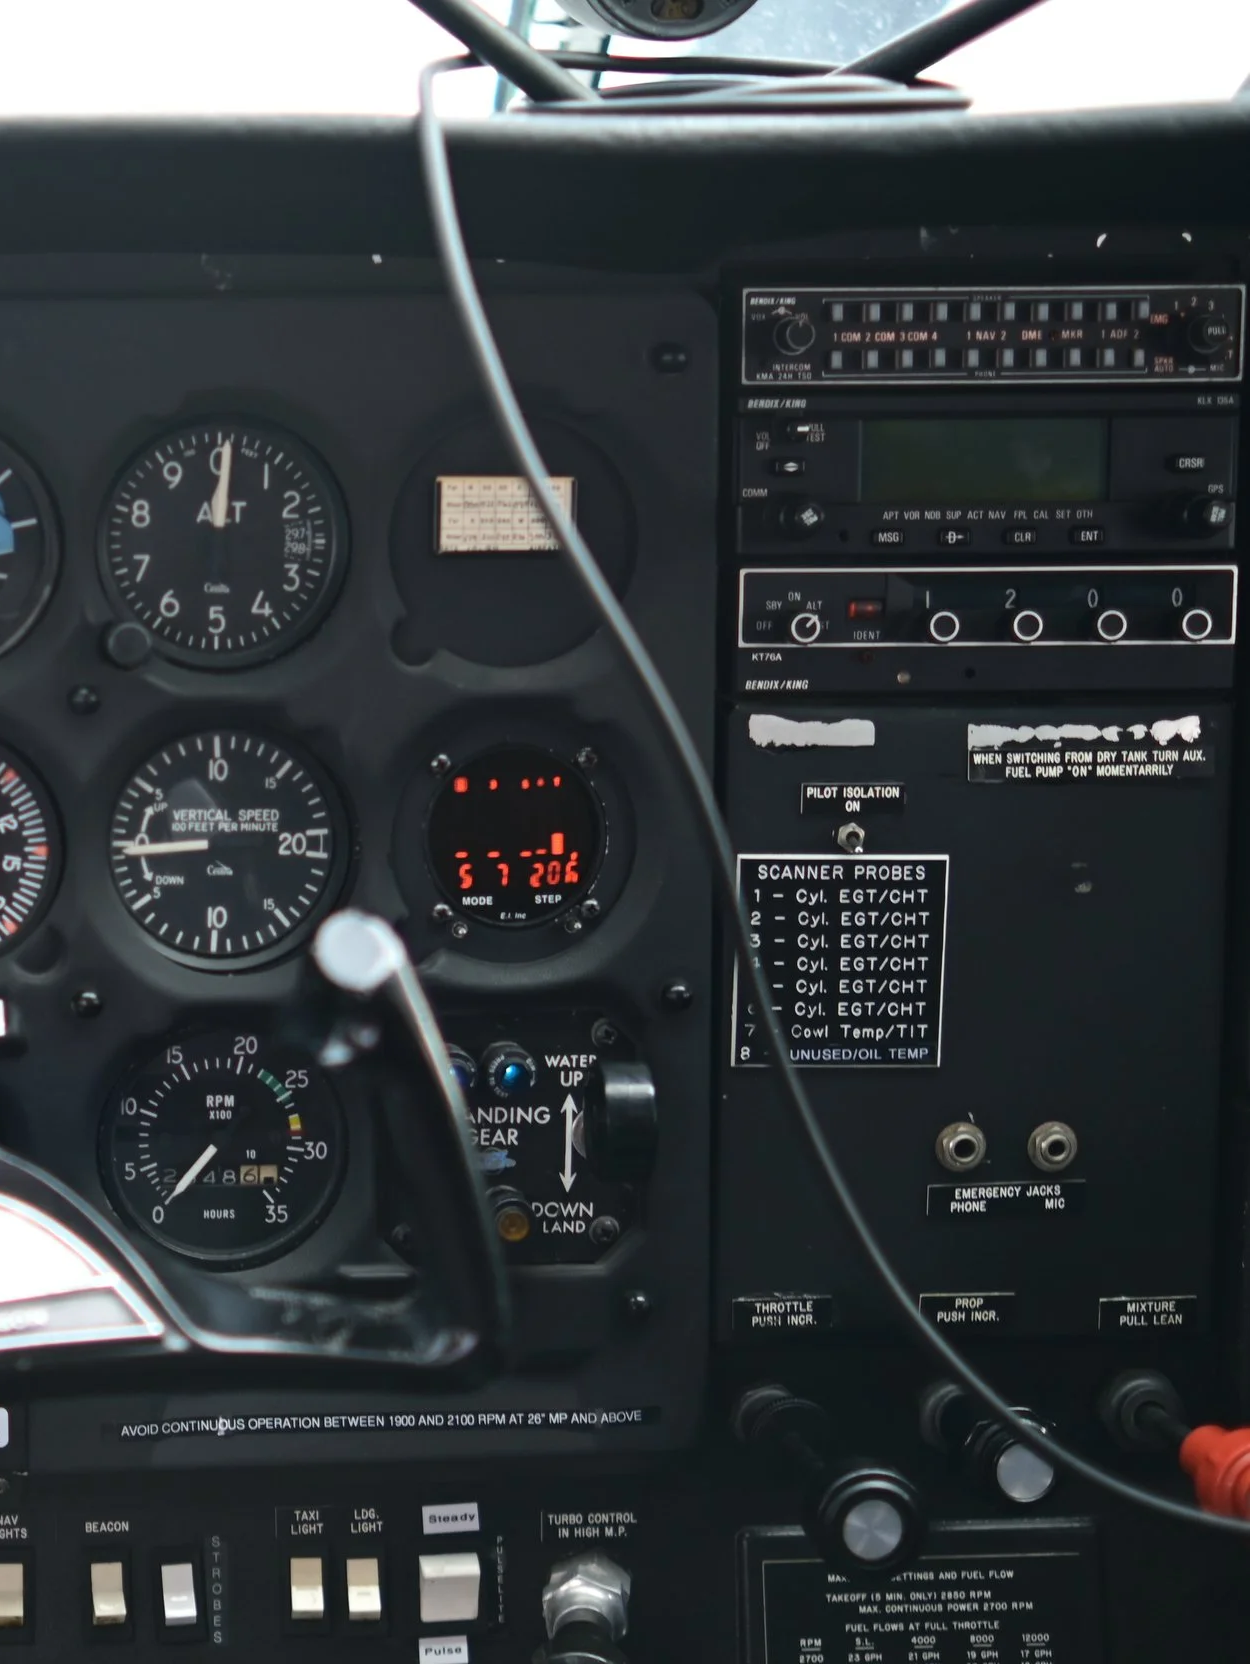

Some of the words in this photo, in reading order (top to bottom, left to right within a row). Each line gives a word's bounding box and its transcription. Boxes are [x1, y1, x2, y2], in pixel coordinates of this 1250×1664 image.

[841, 333, 861, 342] COM
[875, 333, 895, 342] COM
[1022, 331, 1042, 340] DME
[1061, 330, 1083, 339] MKR
[1179, 458, 1204, 469] CRSR
[163, 461, 183, 490] 9
[742, 488, 768, 497] COMM
[131, 499, 151, 528] 8
[882, 511, 899, 520] APT
[903, 511, 920, 520] VOR
[878, 533, 899, 542] MSG
[251, 590, 273, 617] 4
[765, 601, 782, 610] SBY
[806, 601, 822, 610] ALT
[208, 606, 226, 633] 5
[853, 631, 881, 640] IDENT
[751, 653, 782, 661] KT76A
[745, 680, 809, 690] BENDIX/KING
[973, 752, 1002, 765] WHEN
[1006, 752, 1061, 764] SWITCHING
[1065, 751, 1093, 763] FROM
[1097, 751, 1117, 763] DRY
[1121, 750, 1148, 762] TANK
[1152, 750, 1179, 762] TURN
[1183, 749, 1206, 761] AUX.
[1005, 766, 1031, 778] FUEL
[1035, 765, 1063, 778] PUMP
[1067, 765, 1093, 777] "ON"
[1096, 764, 1174, 776] MOMENTARRILY
[806, 787, 838, 799] PILOT
[843, 786, 900, 798] ISOLATION
[845, 800, 860, 812] ON
[172, 809, 232, 821] VERTICAL
[238, 809, 279, 821] SPEED
[171, 823, 187, 832] 100
[190, 823, 215, 832] FEET
[218, 823, 238, 832] PER
[240, 823, 279, 832] MINUTE
[278, 832, 307, 855] 20
[757, 864, 844, 880] SCANNER
[854, 865, 926, 880] PROBES
[155, 875, 184, 885] DOWN
[462, 896, 493, 906] MODE
[535, 894, 562, 904] STEP
[796, 889, 828, 906] Cyl.
[839, 889, 929, 904] EGT/CHT
[791, 1024, 829, 1039] Cowl
[840, 1024, 929, 1041] Temp/TIT
[234, 1036, 258, 1055] 20
[790, 1048, 882, 1061] UNUSED/OIL
[889, 1048, 929, 1060] TEMP
[285, 1070, 309, 1089] 25
[560, 1071, 583, 1087] UP
[206, 1095, 235, 1108] RPM
[209, 1110, 232, 1120] X100
[468, 1129, 519, 1146] GEAR
[303, 1142, 328, 1160] 30
[955, 1186, 1022, 1200] EMERGENCY
[1026, 1185, 1061, 1197] JACKS
[532, 1202, 594, 1218] DOWN
[950, 1201, 987, 1213] PHONE
[1045, 1198, 1065, 1210] MIC
[203, 1209, 235, 1220] HOURS
[543, 1220, 586, 1234] LAND
[754, 1301, 814, 1314] THROTTLE
[955, 1298, 984, 1309] PROP
[1127, 1301, 1176, 1313] MIXTURE
[751, 1315, 782, 1328] PUSH
[787, 1313, 817, 1326] INCR.
[1120, 1315, 1148, 1327] PULL
[1153, 1313, 1183, 1326] LEAN
[121, 1423, 159, 1437] AVOID
[162, 1418, 245, 1434] CONTINUOUS
[248, 1417, 321, 1430] OPERATION
[324, 1415, 385, 1428] BETWEEN
[389, 1414, 415, 1427] 1900
[418, 1414, 444, 1426] AND
[447, 1413, 475, 1426] 2100
[478, 1413, 506, 1425] RPM
[509, 1413, 524, 1425] AT
[549, 1412, 567, 1424] MP
[571, 1412, 597, 1424] AND
[600, 1410, 641, 1423] ABOVE
[294, 1510, 319, 1521] TAXI
[429, 1512, 476, 1525] Steady
[547, 1513, 583, 1525] TURBO
[587, 1512, 637, 1524] CONTROL
[85, 1521, 129, 1534] BEACON
[291, 1523, 323, 1535] LIGHT
[574, 1527, 600, 1538] HIGH
[961, 1570, 985, 1579] FUEL
[989, 1570, 1014, 1579] FLOW
[212, 1536, 223, 1644] STROBES
[826, 1593, 867, 1602] TAKEOFF
[947, 1602, 979, 1612] POWER
[952, 1620, 1000, 1630] THROTTLE
[424, 1646, 462, 1656] Pulse
